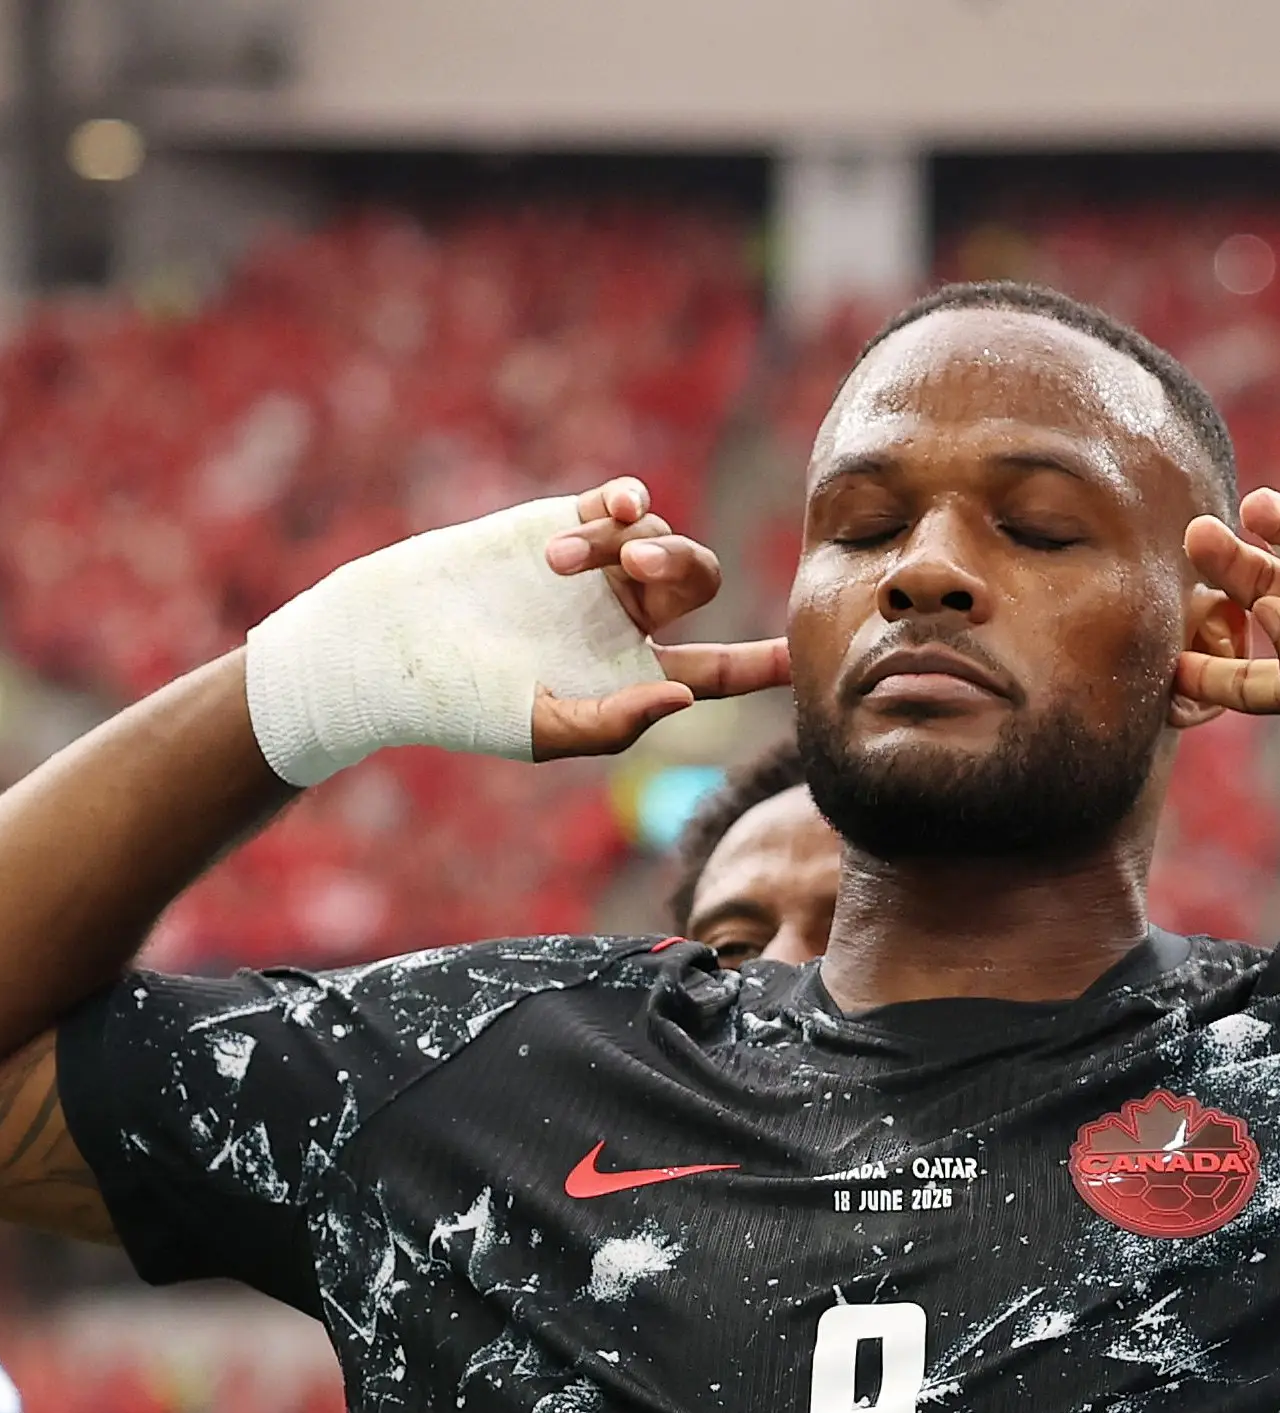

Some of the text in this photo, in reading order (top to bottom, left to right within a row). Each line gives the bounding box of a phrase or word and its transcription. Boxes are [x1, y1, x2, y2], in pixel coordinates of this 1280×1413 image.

[912, 1157, 978, 1179] QATAR
[1080, 1151, 1248, 1174] CANADA
[833, 1188, 953, 1212] 18 JUNE 2026
